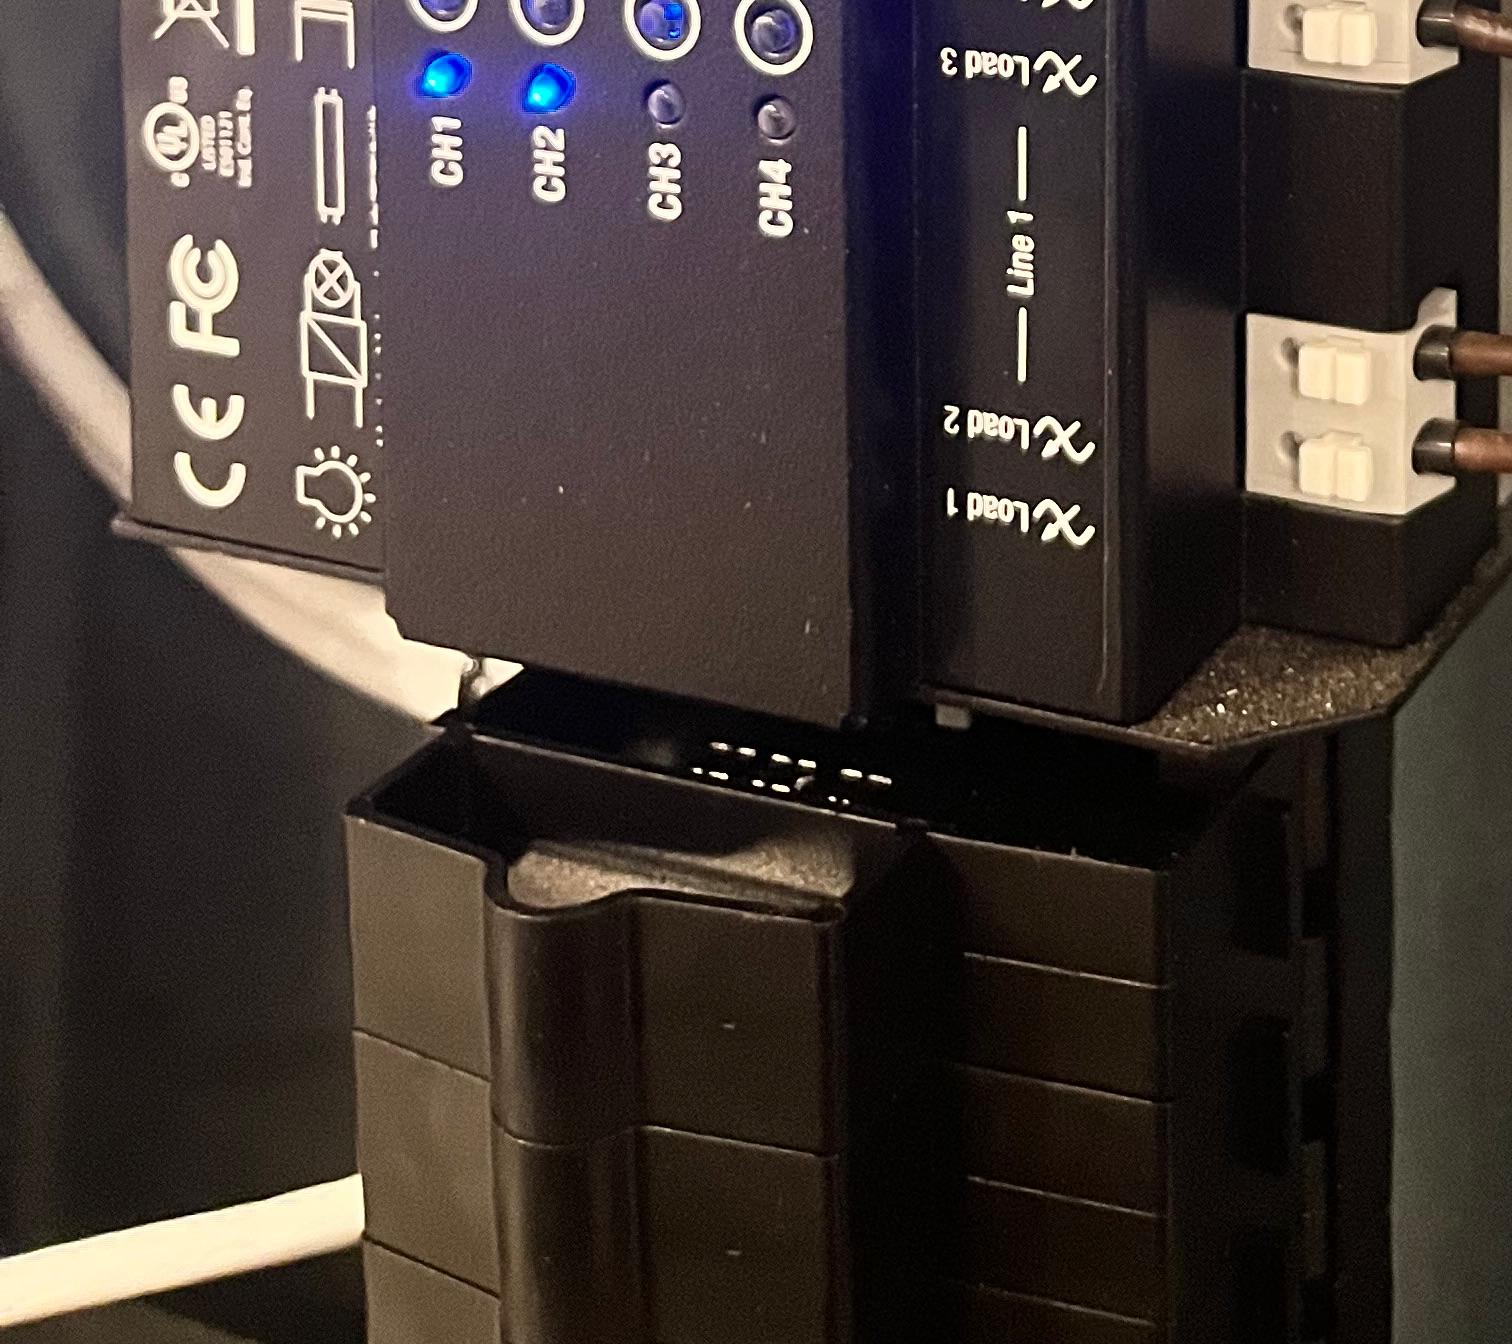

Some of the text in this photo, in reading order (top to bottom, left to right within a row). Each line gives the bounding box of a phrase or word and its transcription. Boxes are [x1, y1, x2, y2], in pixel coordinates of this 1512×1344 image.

[940, 47, 1030, 87] Load 3
[430, 116, 464, 187] CH1
[532, 125, 566, 203] CH2
[647, 142, 682, 221] CH3
[757, 158, 794, 238] CH4
[1006, 210, 1035, 297] Line 1
[171, 383, 247, 508] CE
[943, 404, 1030, 450] Load 2
[946, 487, 1030, 533] Load 1
